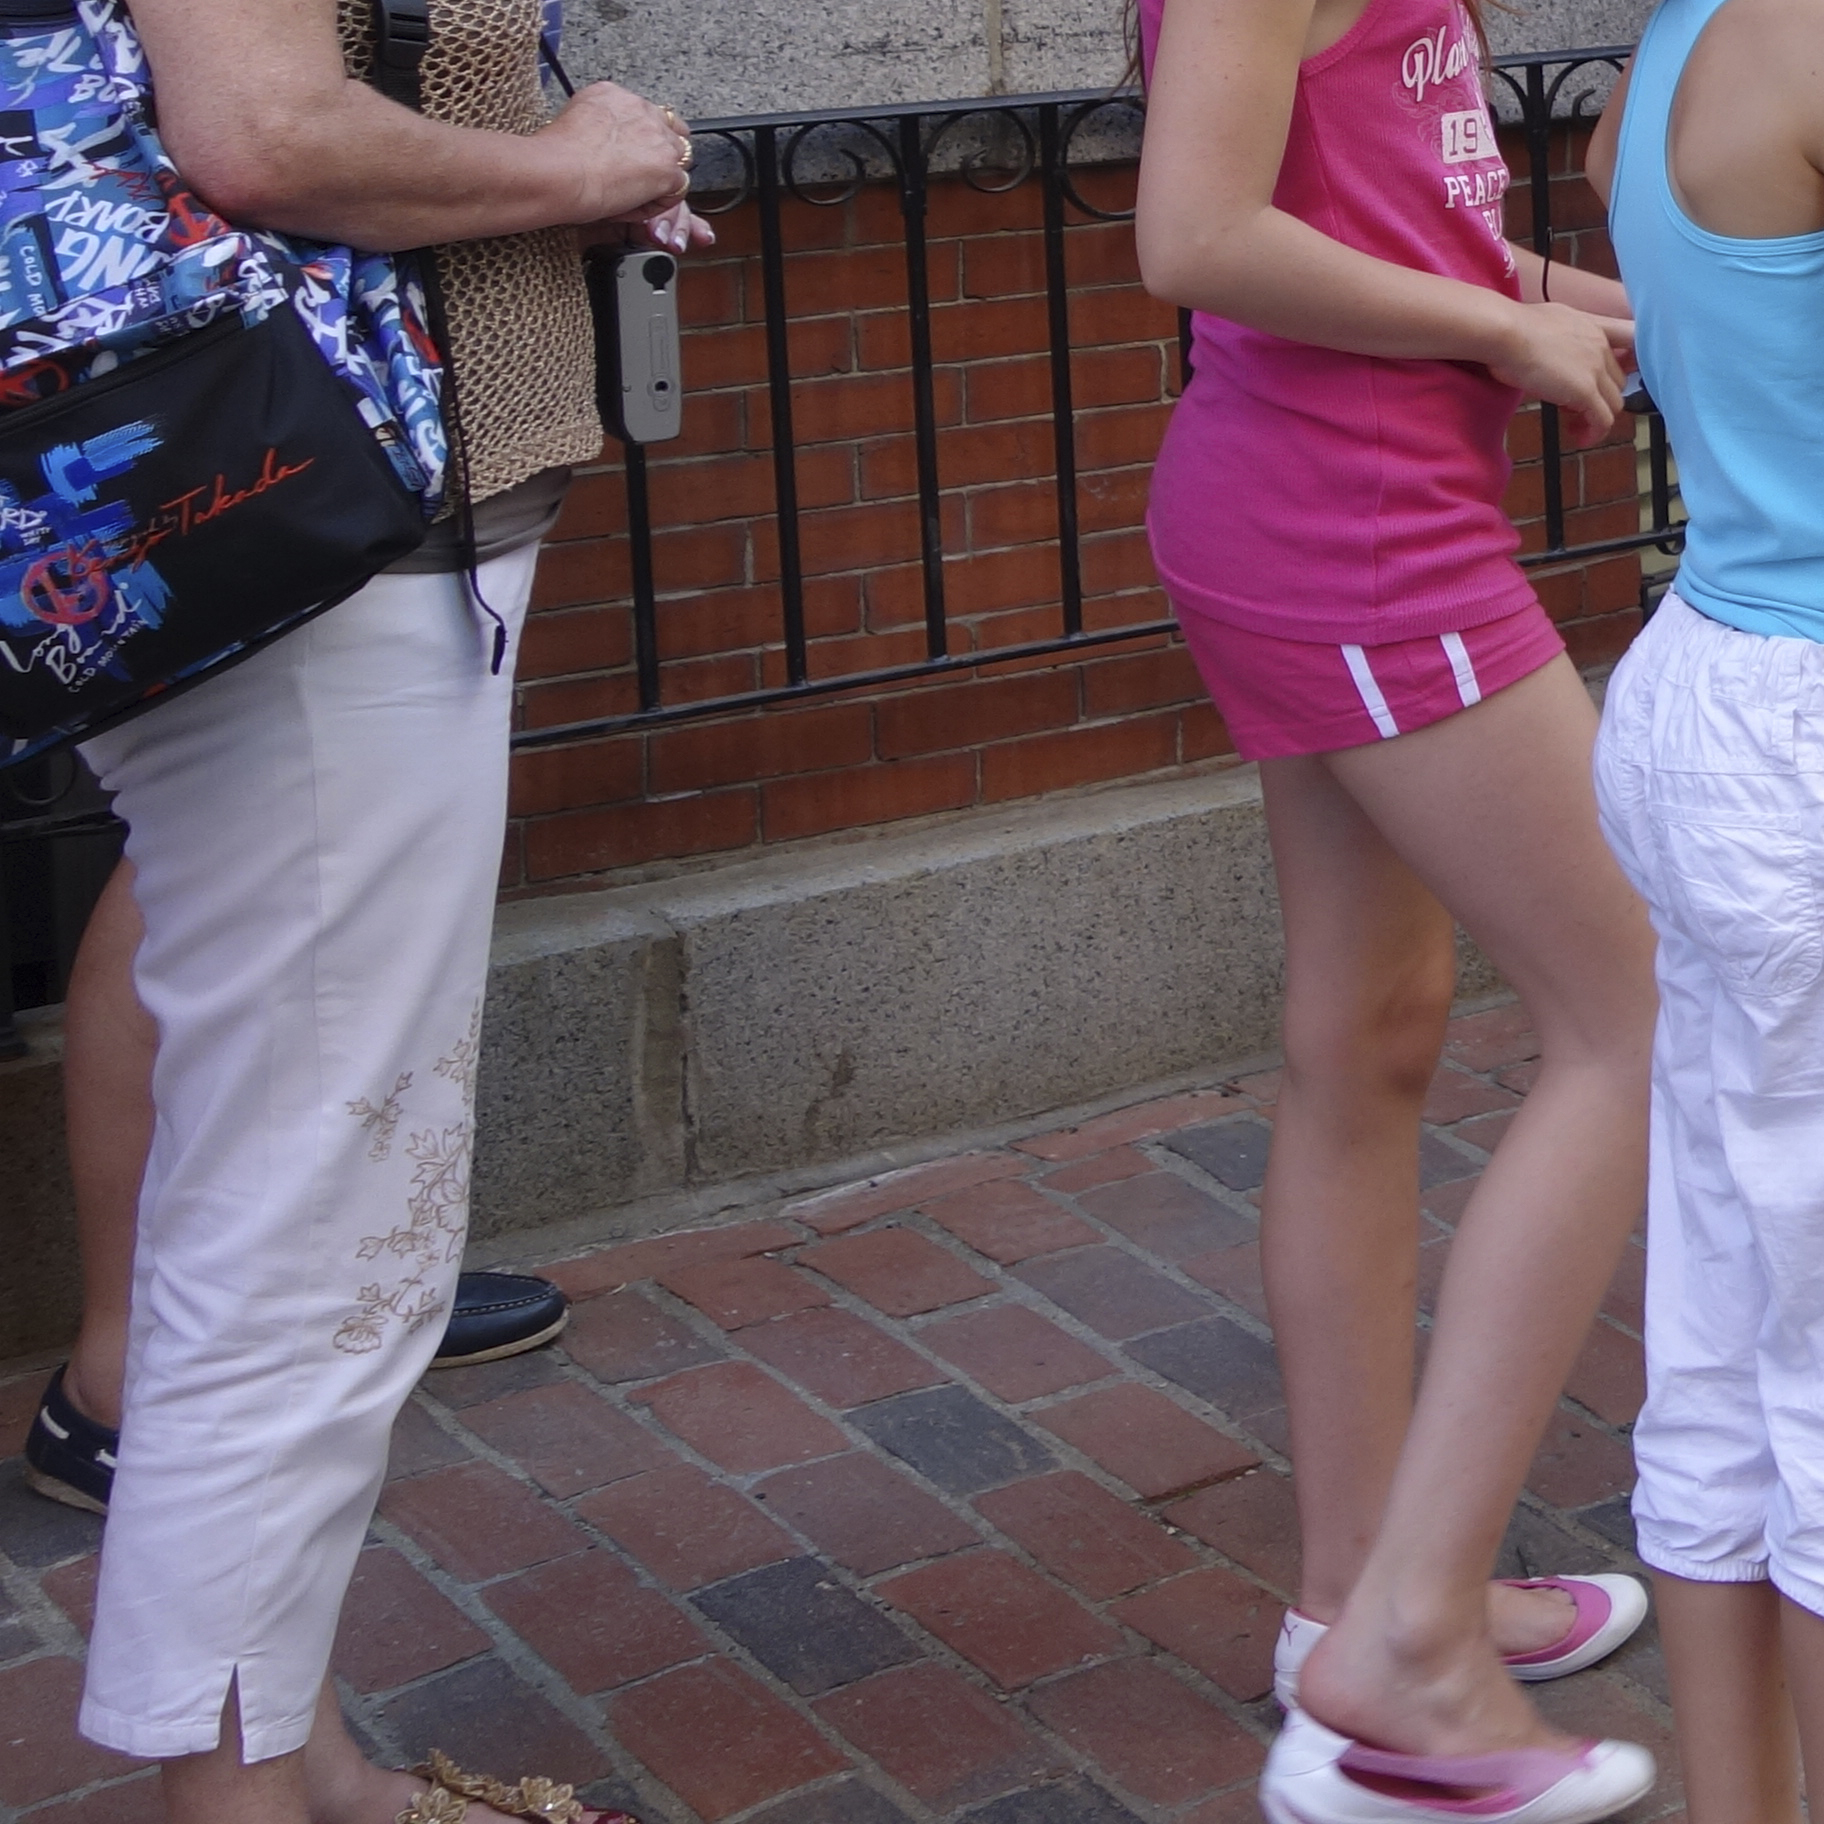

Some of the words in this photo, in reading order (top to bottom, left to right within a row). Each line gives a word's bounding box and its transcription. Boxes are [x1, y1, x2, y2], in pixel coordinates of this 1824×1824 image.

[1443, 168, 1508, 209] PEACE
[159, 447, 316, 535] Takada
[68, 667, 96, 693] COLD
